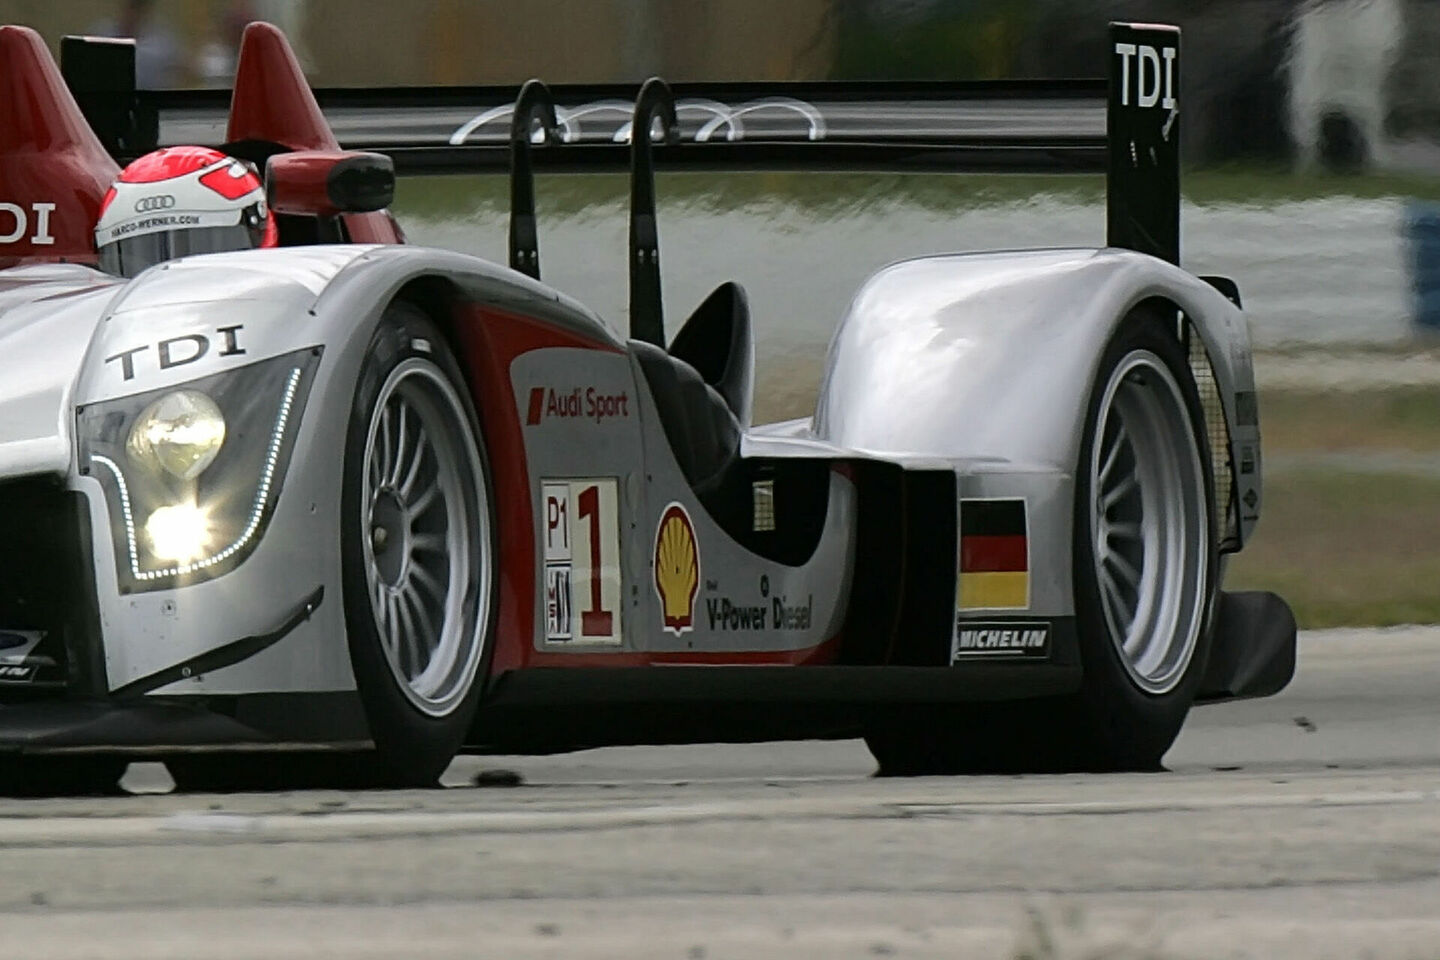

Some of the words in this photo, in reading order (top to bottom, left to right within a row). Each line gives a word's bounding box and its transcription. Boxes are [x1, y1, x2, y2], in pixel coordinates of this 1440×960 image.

[1115, 43, 1176, 109] TDI
[111, 215, 200, 237] MARCO-WERNER.COM
[105, 324, 246, 381] TDI
[546, 387, 582, 417] Audi
[586, 386, 628, 424] Sport
[547, 496, 568, 548] P1
[578, 485, 613, 636] 1
[706, 598, 767, 631] V-Power
[772, 595, 812, 631] Diesel
[960, 629, 1047, 648] MICHELIN
